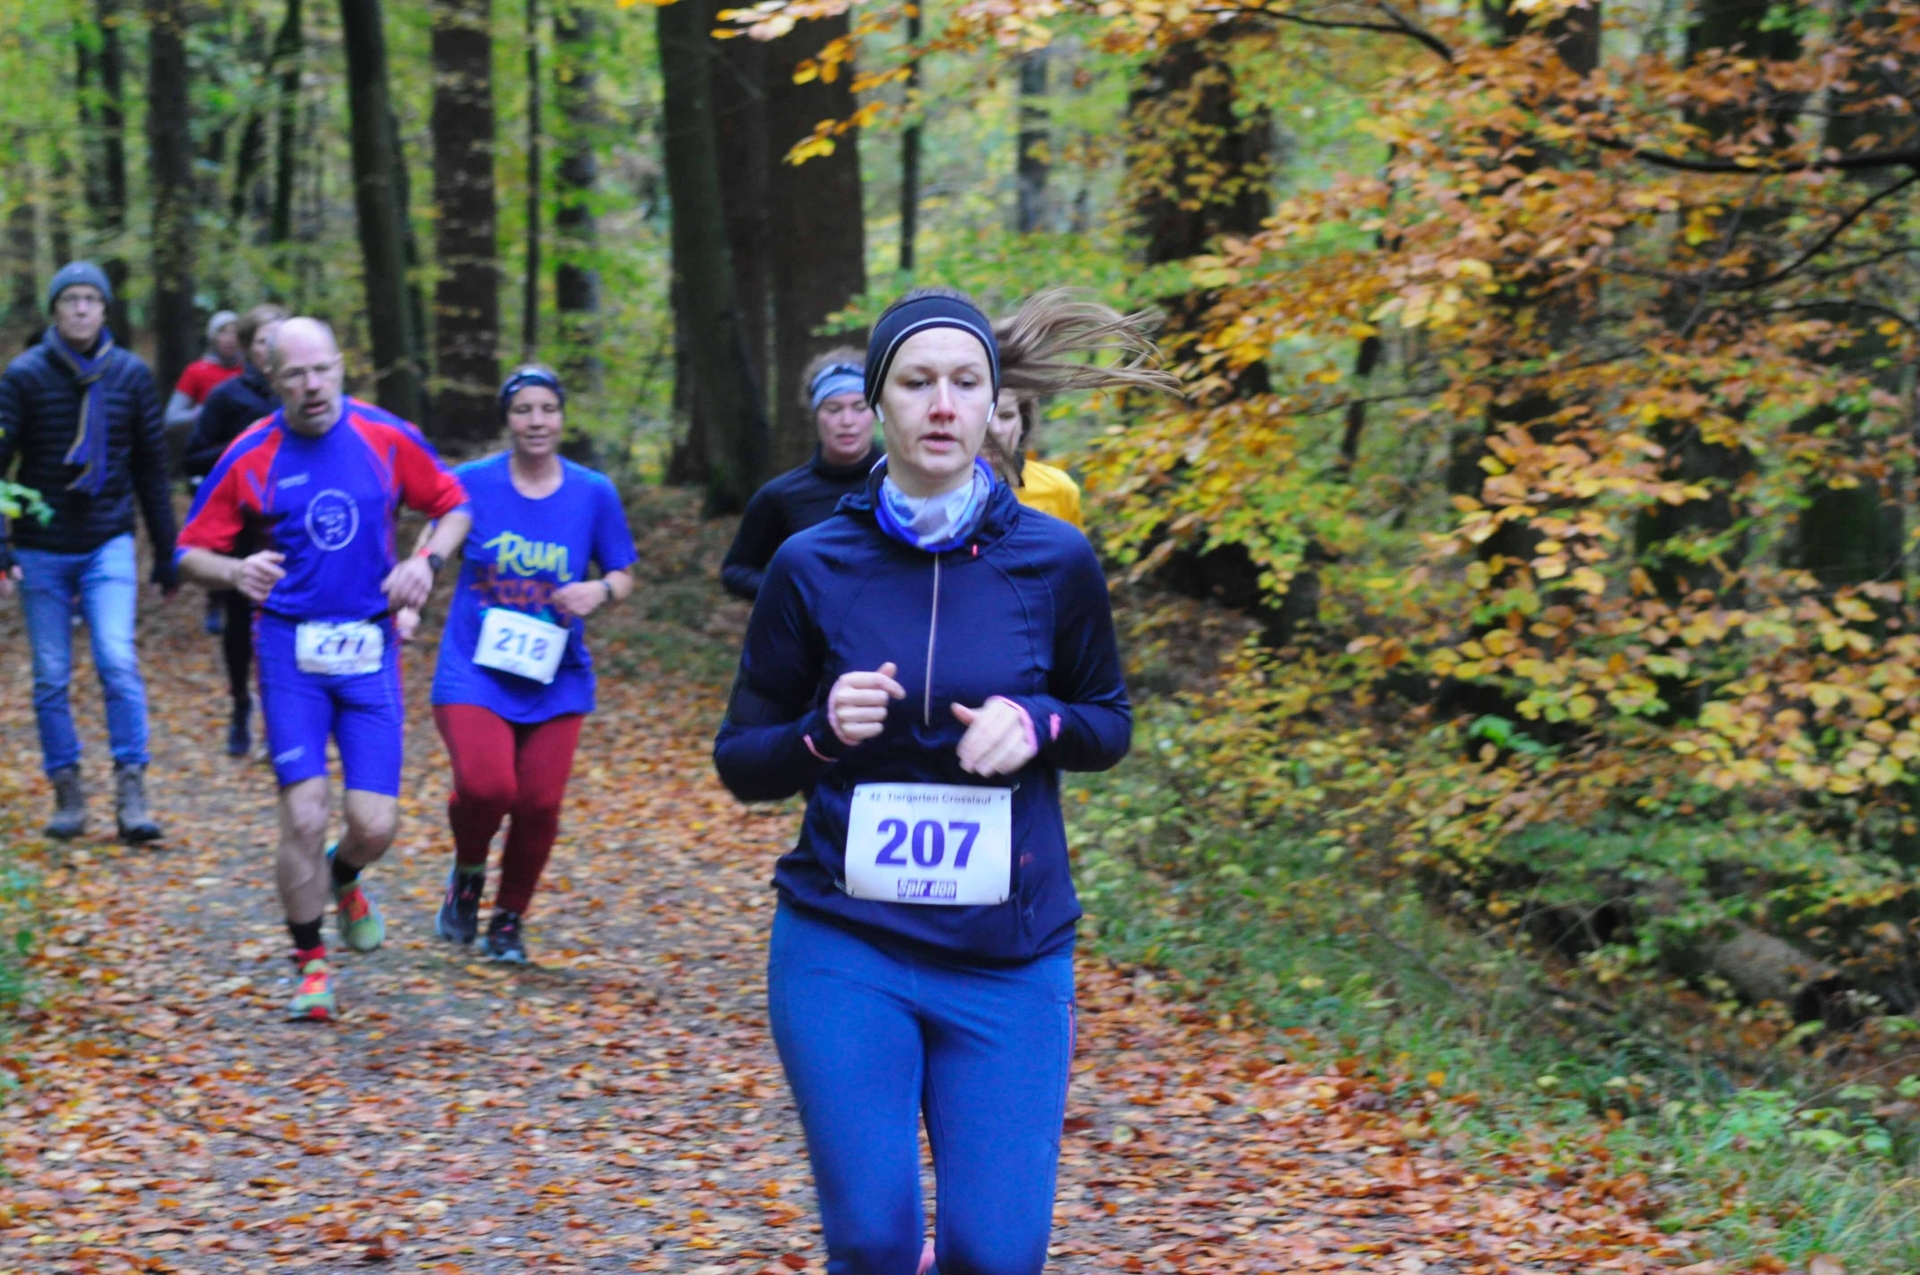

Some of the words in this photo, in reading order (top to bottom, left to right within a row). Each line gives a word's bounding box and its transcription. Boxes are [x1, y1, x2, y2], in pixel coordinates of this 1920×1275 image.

[482, 531, 573, 582] Run
[494, 627, 549, 661] 218
[888, 793, 938, 804] Tiergarten
[942, 794, 991, 805] Crosslauf
[875, 818, 980, 869] 207
